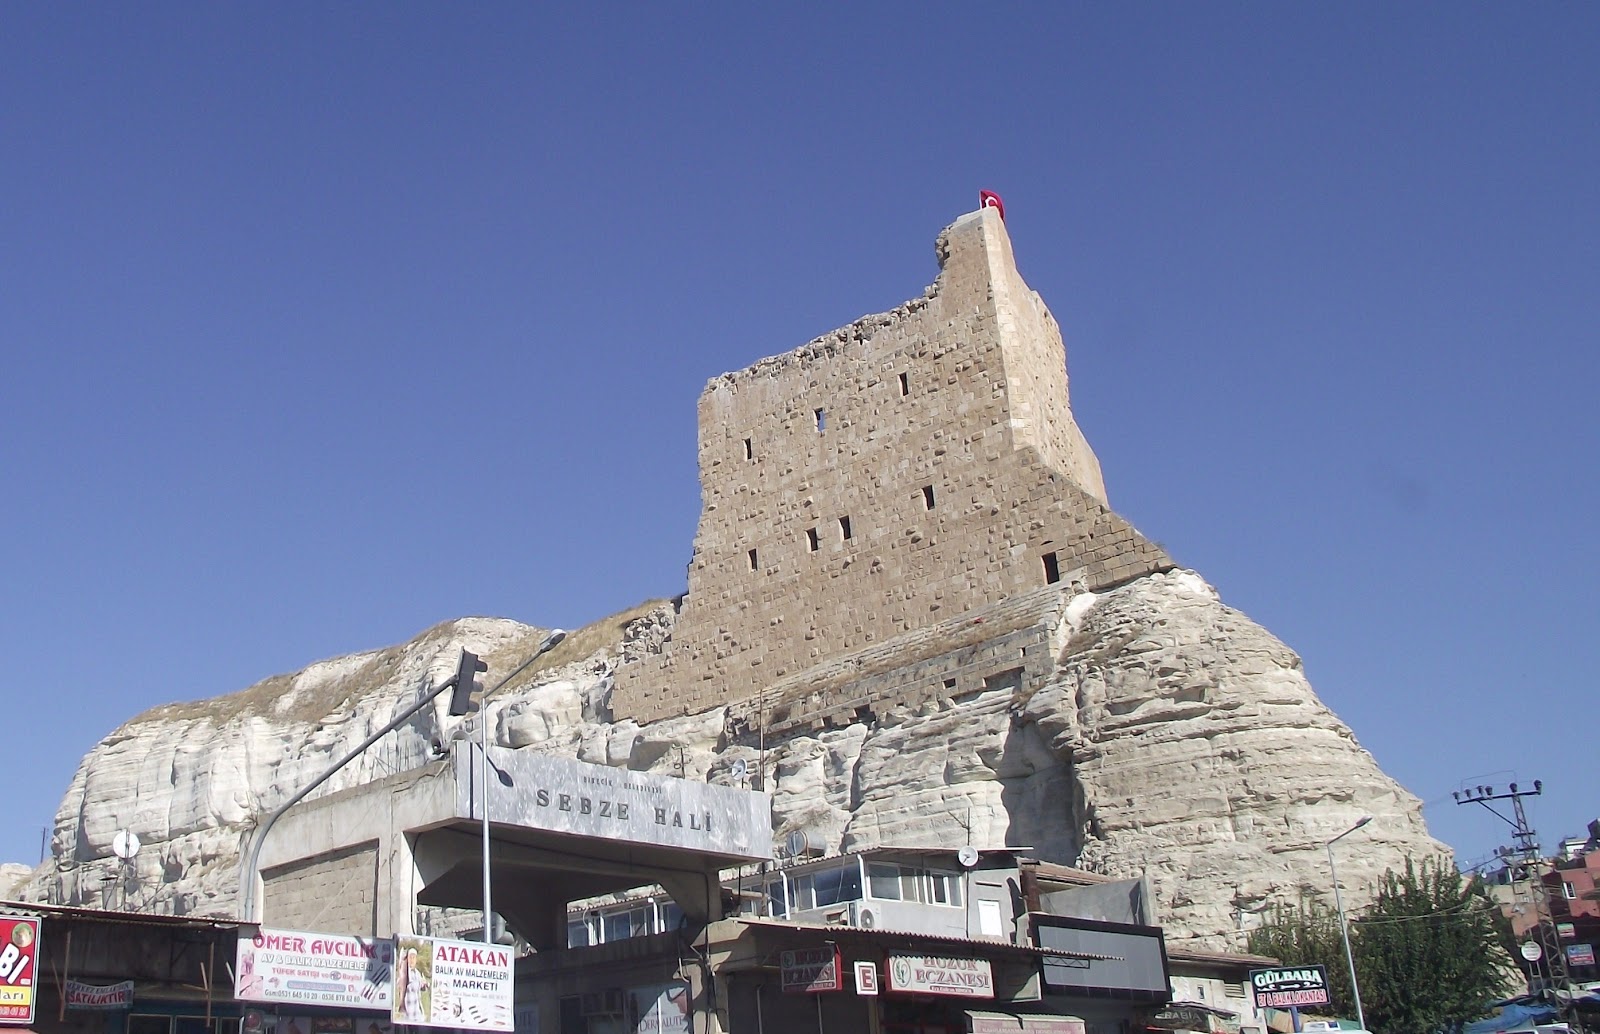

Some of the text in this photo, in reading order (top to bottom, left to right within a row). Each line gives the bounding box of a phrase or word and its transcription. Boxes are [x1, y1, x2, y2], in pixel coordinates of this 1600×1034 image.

[537, 790, 712, 833] SEBZE HALİ
[311, 939, 378, 959] AVCILIK
[436, 945, 509, 968] ATAKAN
[261, 953, 275, 963] AV
[285, 957, 313, 967] BALIK
[435, 965, 509, 981] BALIK AV MALZEMELERİ
[860, 968, 873, 987] E
[915, 968, 990, 989] ECZANESİ
[1254, 970, 1323, 987] GÜLBABA
[69, 991, 125, 1005] SATILIKTIR
